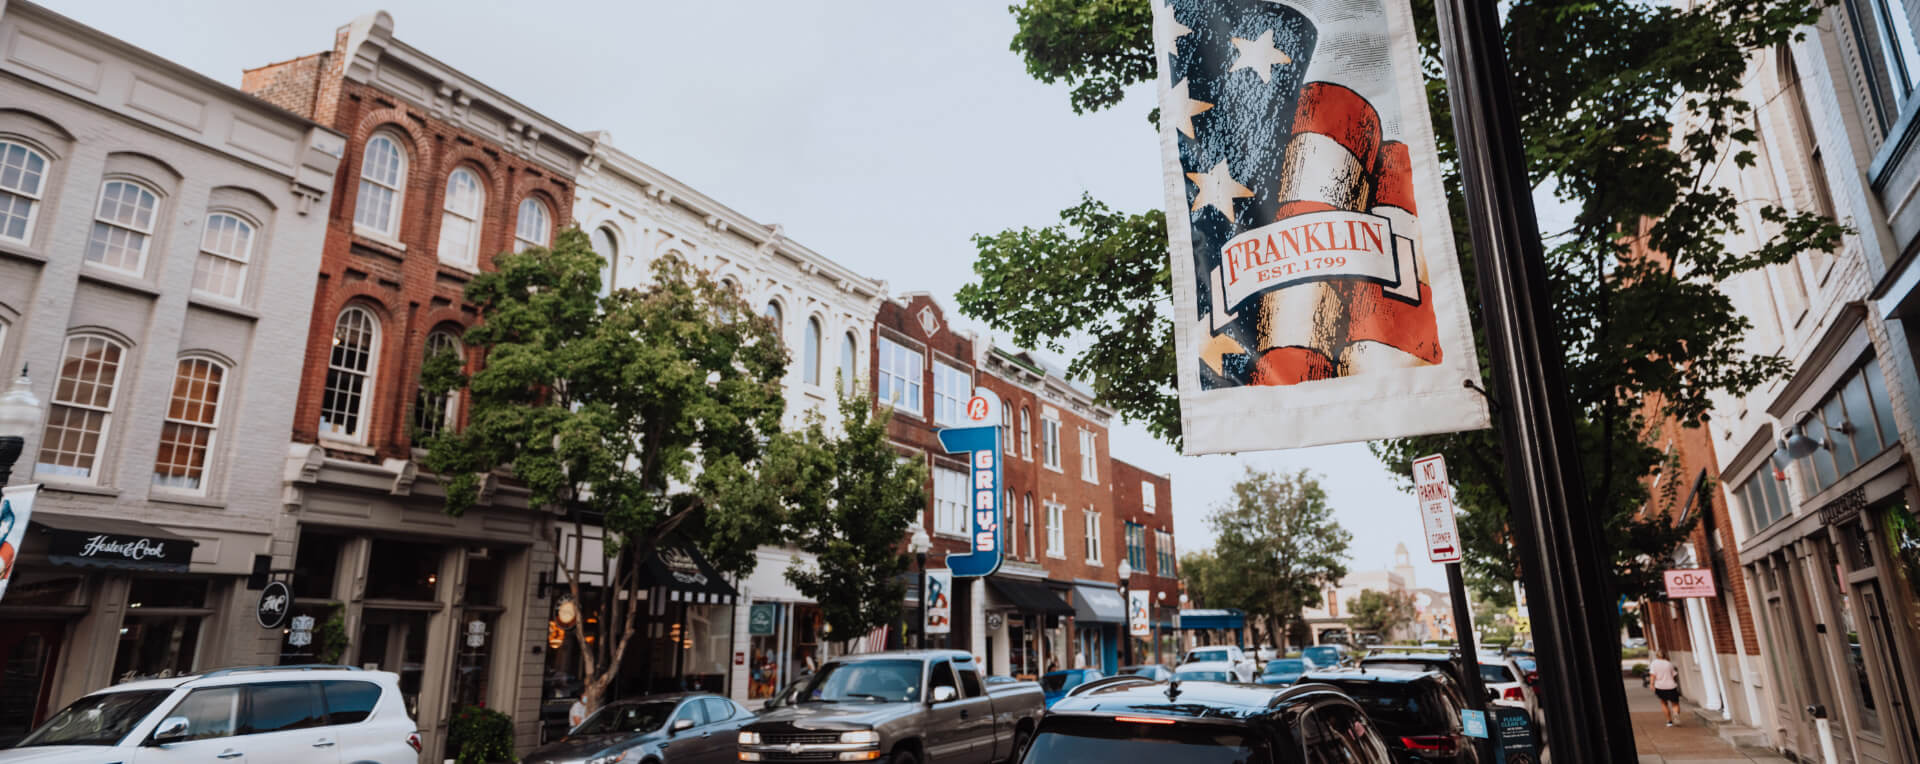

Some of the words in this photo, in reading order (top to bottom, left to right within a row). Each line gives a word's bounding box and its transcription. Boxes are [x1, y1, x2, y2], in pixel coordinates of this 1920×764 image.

[1224, 220, 1384, 286] FRANKLIN
[1423, 462, 1436, 480] NO
[1419, 481, 1447, 500] PARKING
[975, 450, 997, 552] GRAY'S
[1432, 531, 1451, 544] CORNER
